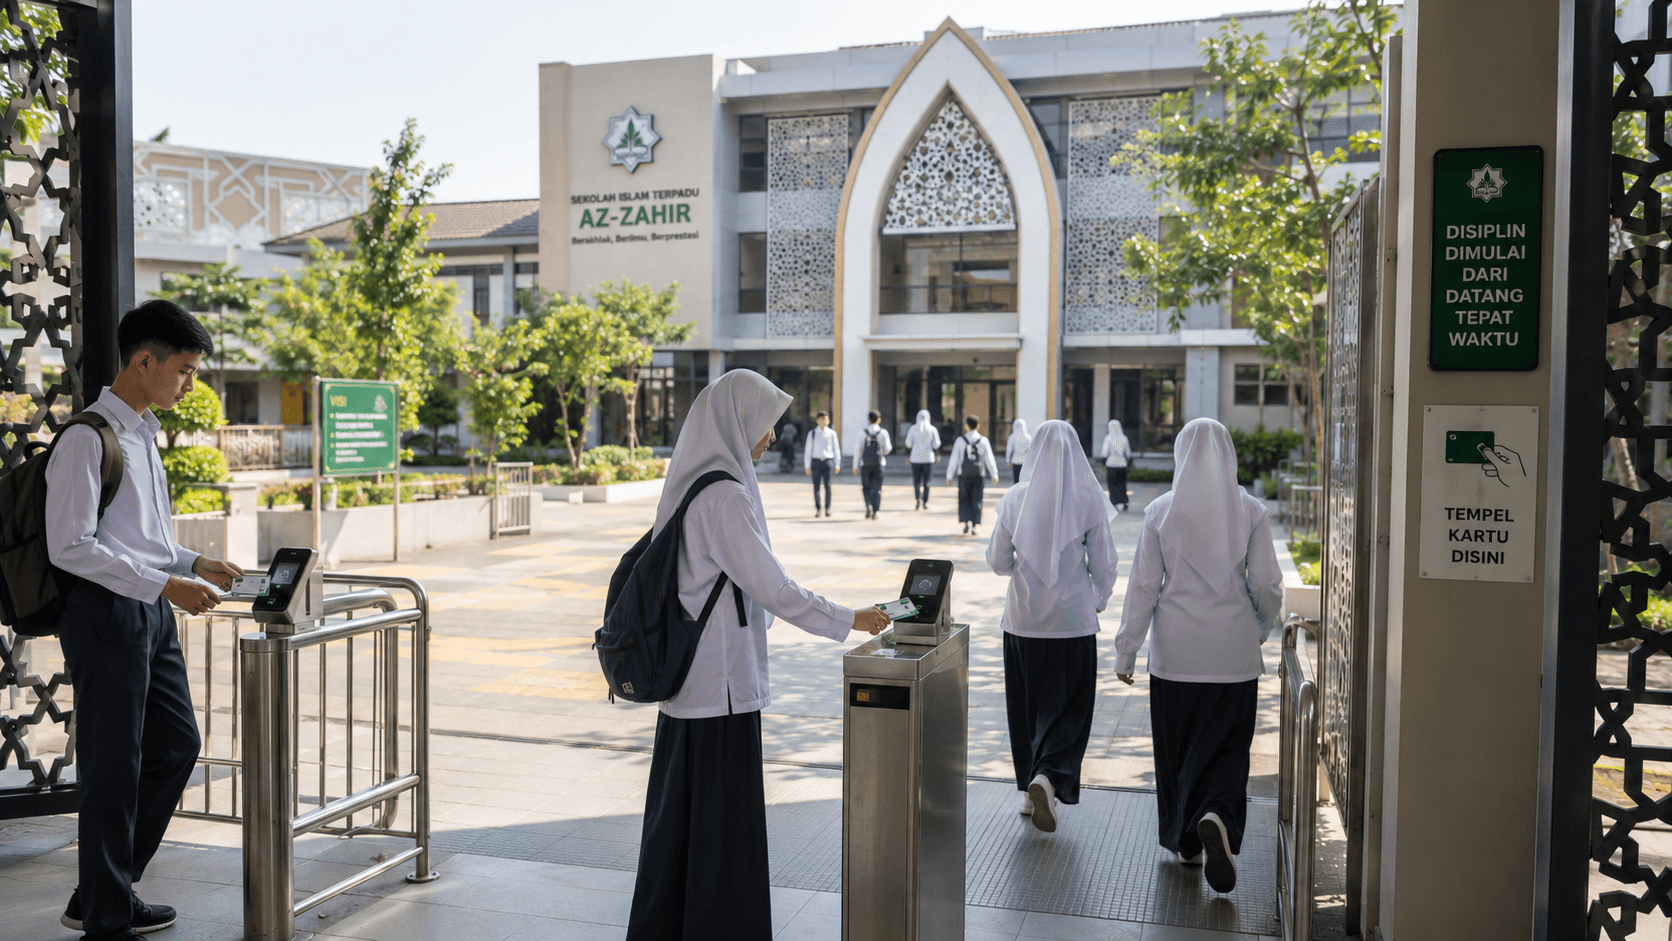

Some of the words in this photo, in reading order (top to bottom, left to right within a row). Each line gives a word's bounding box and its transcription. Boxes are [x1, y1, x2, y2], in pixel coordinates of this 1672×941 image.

[571, 194, 616, 204] SEKOLAH
[619, 191, 649, 201] ISLAM
[652, 188, 699, 200] TERPADU
[579, 203, 691, 229] AZ-ZAHIR
[651, 231, 699, 242] Berprestasi
[1446, 223, 1526, 239] DISIPLIN
[1445, 245, 1526, 260] DIMULAI
[1462, 267, 1508, 282] DARI
[1446, 288, 1524, 303] DATANG
[1455, 310, 1513, 325] TEPAT
[1449, 332, 1519, 346] WAKTU
[1444, 507, 1514, 522] TEMPEL
[1448, 528, 1509, 544] KARTU
[1451, 549, 1505, 564] DISINI
